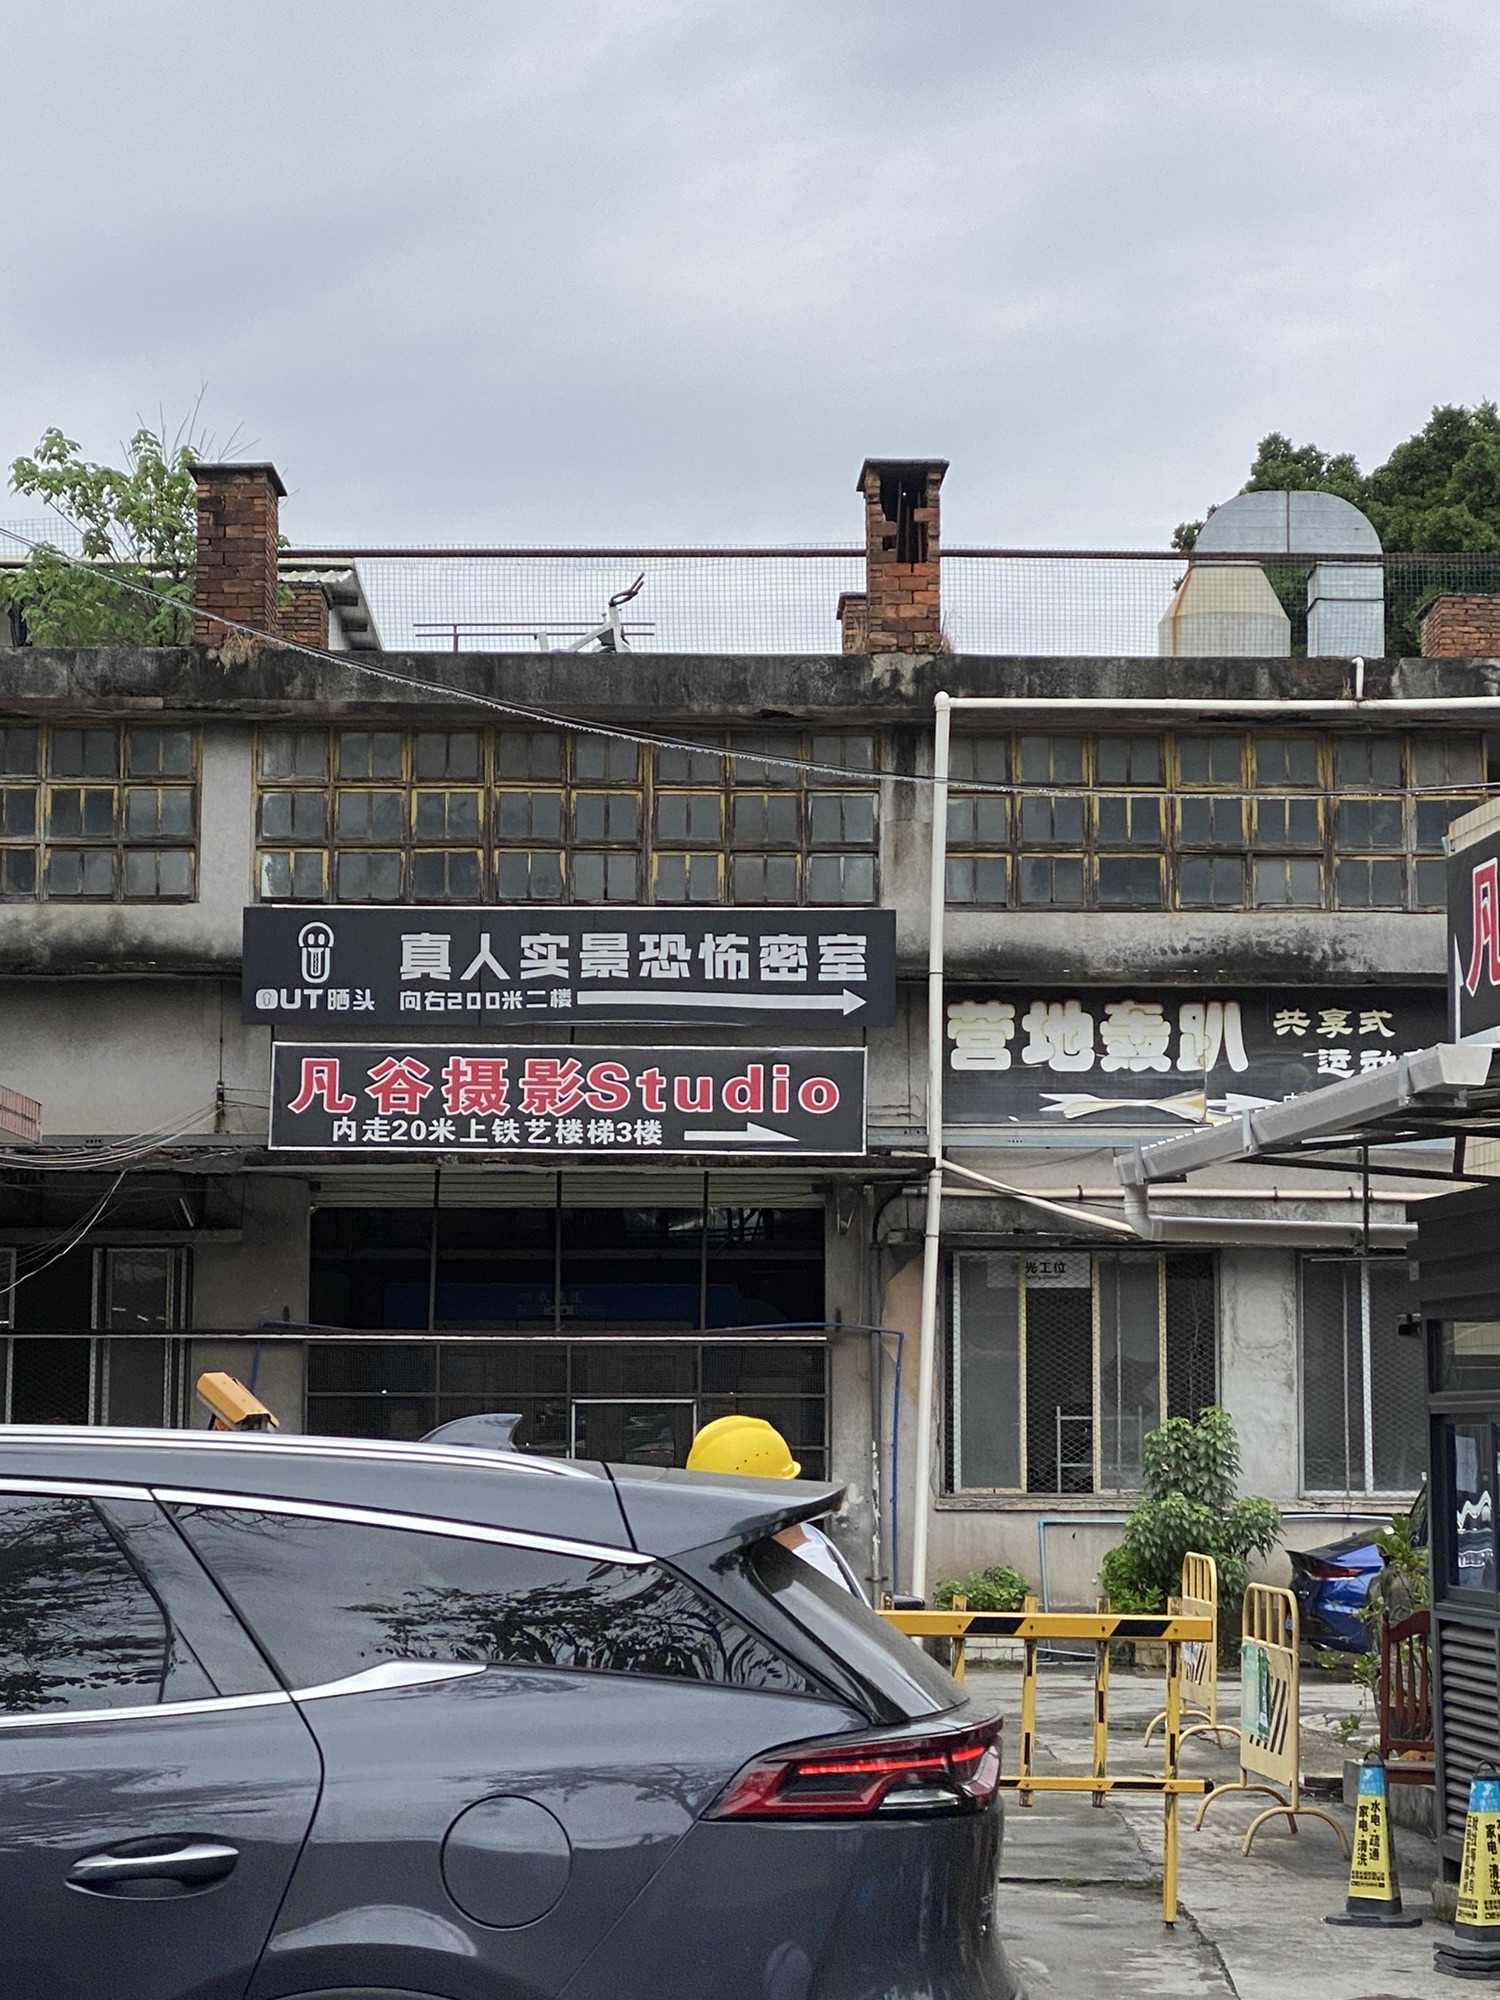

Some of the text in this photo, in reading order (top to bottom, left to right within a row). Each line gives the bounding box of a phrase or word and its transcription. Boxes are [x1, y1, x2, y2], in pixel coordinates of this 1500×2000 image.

[400, 932, 867, 981] 真人实景恐怖密室
[400, 988, 572, 1012] 向右200米二楼
[947, 1000, 1249, 1073] 营地轰趴
[1273, 1008, 1396, 1038] 共享式
[1317, 1048, 1424, 1078] 运动
[288, 1056, 840, 1117] 凡谷摄影Studio
[332, 1117, 663, 1146] 内走20米上铁艺楼梯3楼
